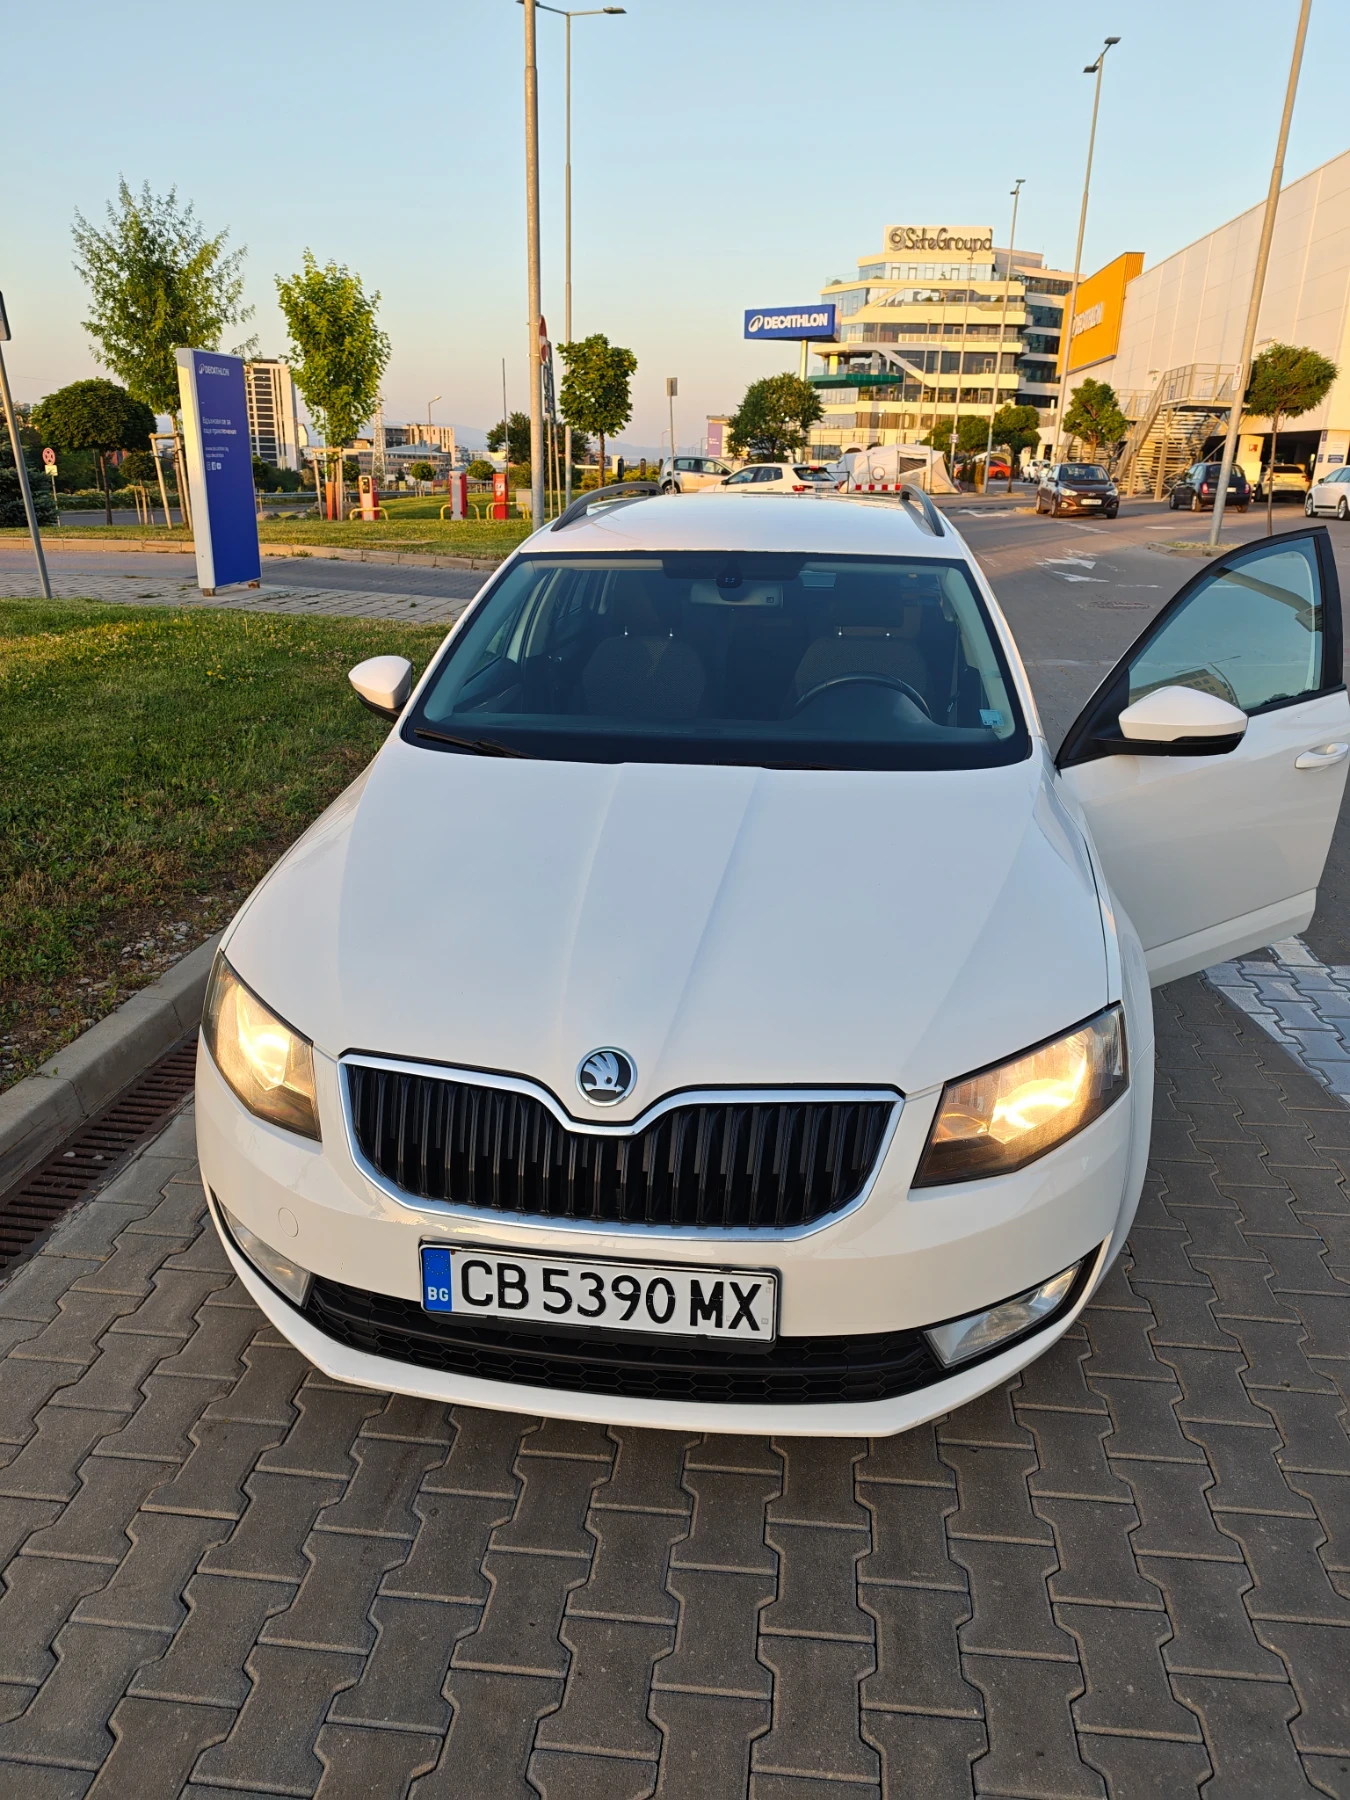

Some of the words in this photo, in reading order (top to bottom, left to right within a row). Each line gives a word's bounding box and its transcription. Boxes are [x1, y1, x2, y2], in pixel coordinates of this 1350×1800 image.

[905, 227, 993, 251] SiteGround
[763, 313, 829, 330] DECATHLON
[427, 1286, 449, 1302] BG
[461, 1259, 530, 1311] CB
[542, 1268, 676, 1325] 5390
[689, 1279, 763, 1332] MX
